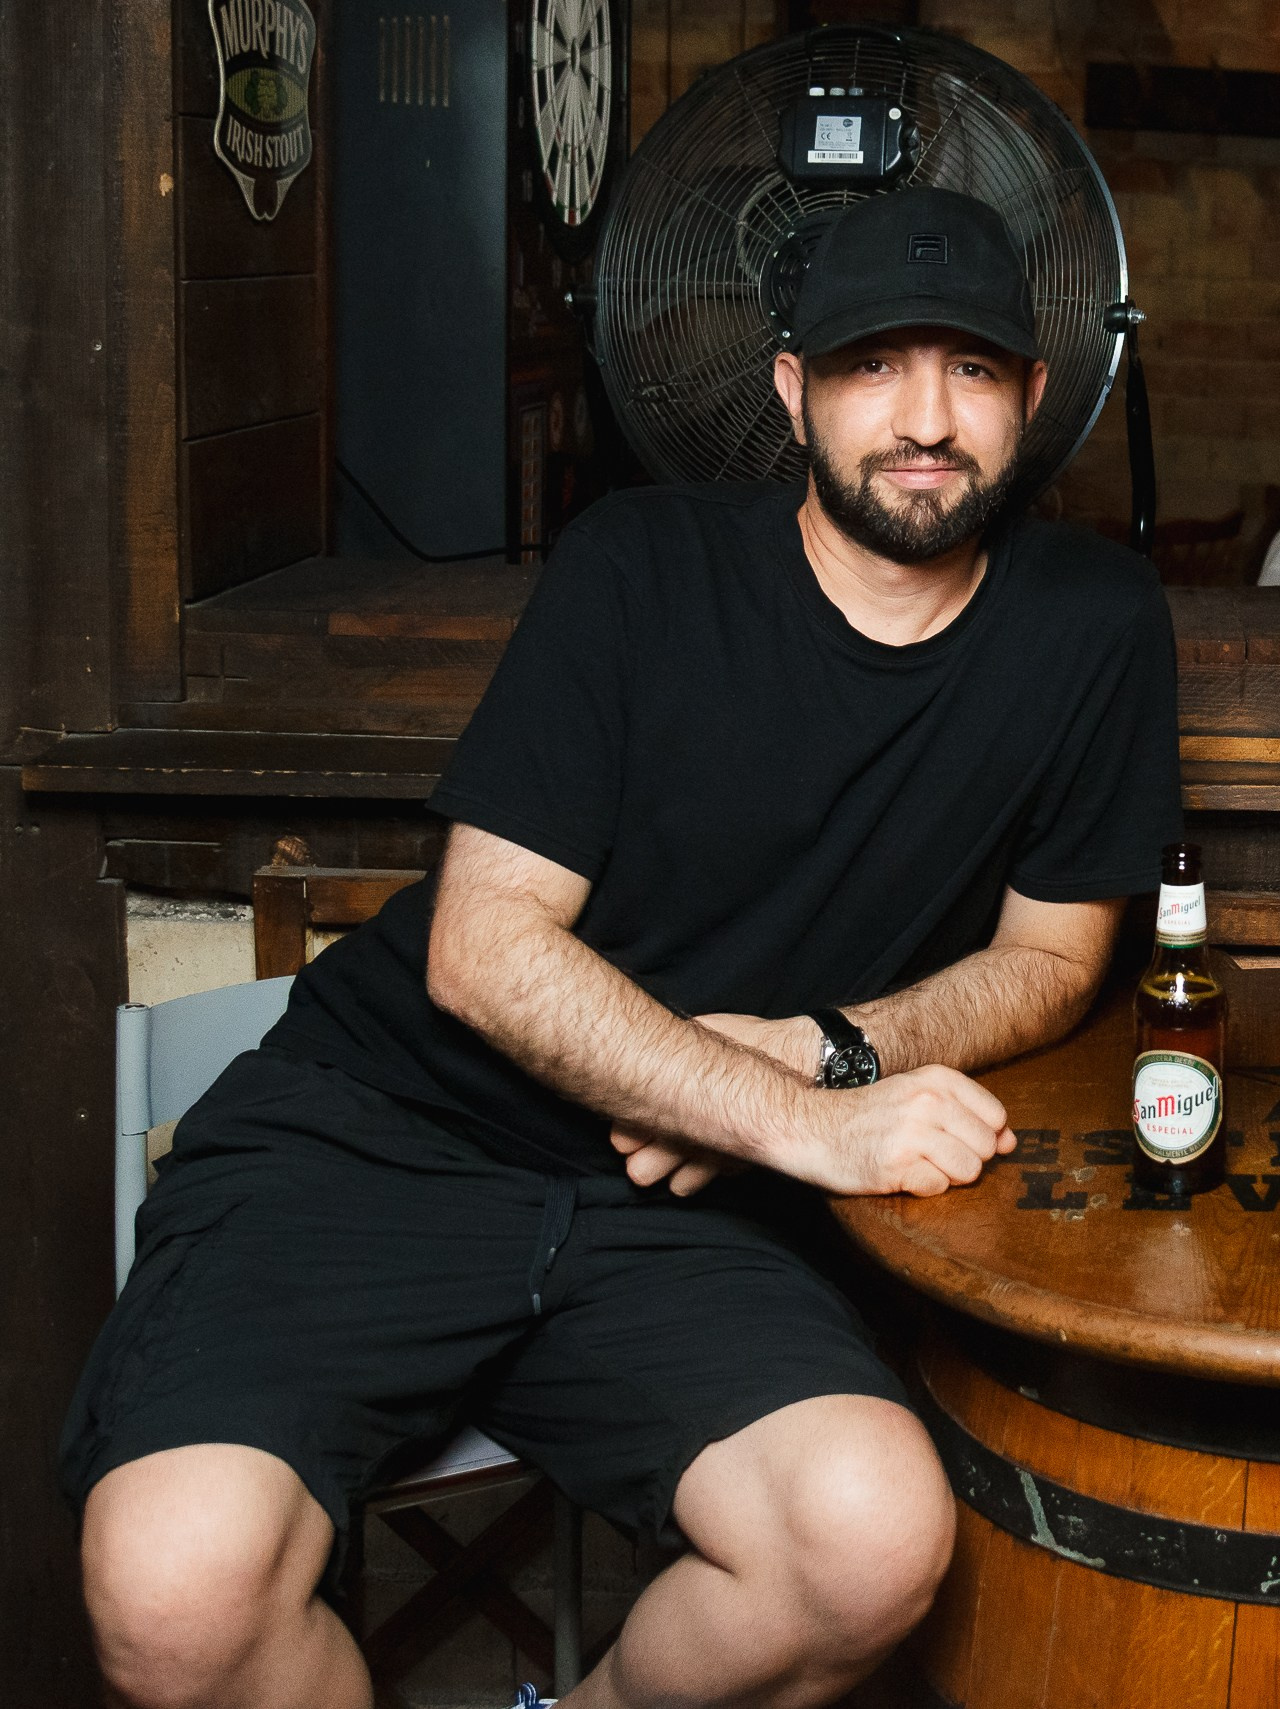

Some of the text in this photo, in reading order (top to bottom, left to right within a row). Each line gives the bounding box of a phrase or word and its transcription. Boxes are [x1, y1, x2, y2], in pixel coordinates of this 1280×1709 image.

[225, 114, 305, 169] IRISH STOUT
[1146, 1123, 1194, 1135] ESPECIAL
